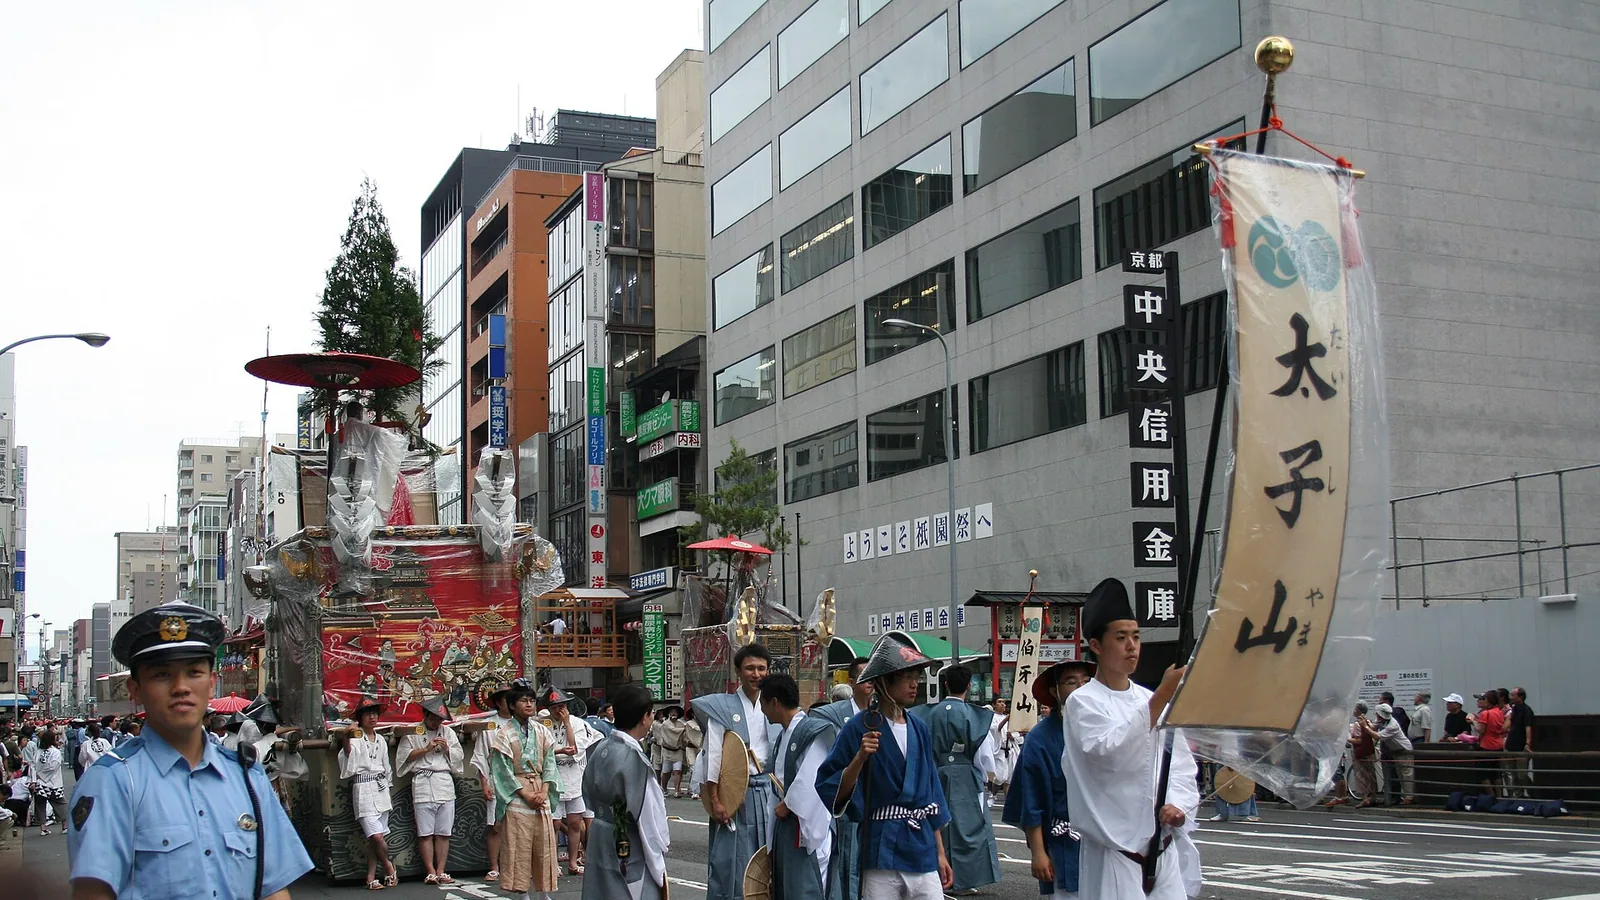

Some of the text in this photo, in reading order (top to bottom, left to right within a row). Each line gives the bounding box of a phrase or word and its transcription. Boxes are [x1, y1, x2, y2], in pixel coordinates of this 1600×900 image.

[650, 440, 664, 456] 内科
[678, 433, 700, 447] 内科
[1130, 251, 1176, 622] 京都 中央信用金庫
[637, 480, 673, 513] 大クマ眼科
[1234, 311, 1338, 655] 太子山
[845, 510, 992, 560] ようこそ祇園祭へ
[1016, 638, 1035, 714] 伯牙山
